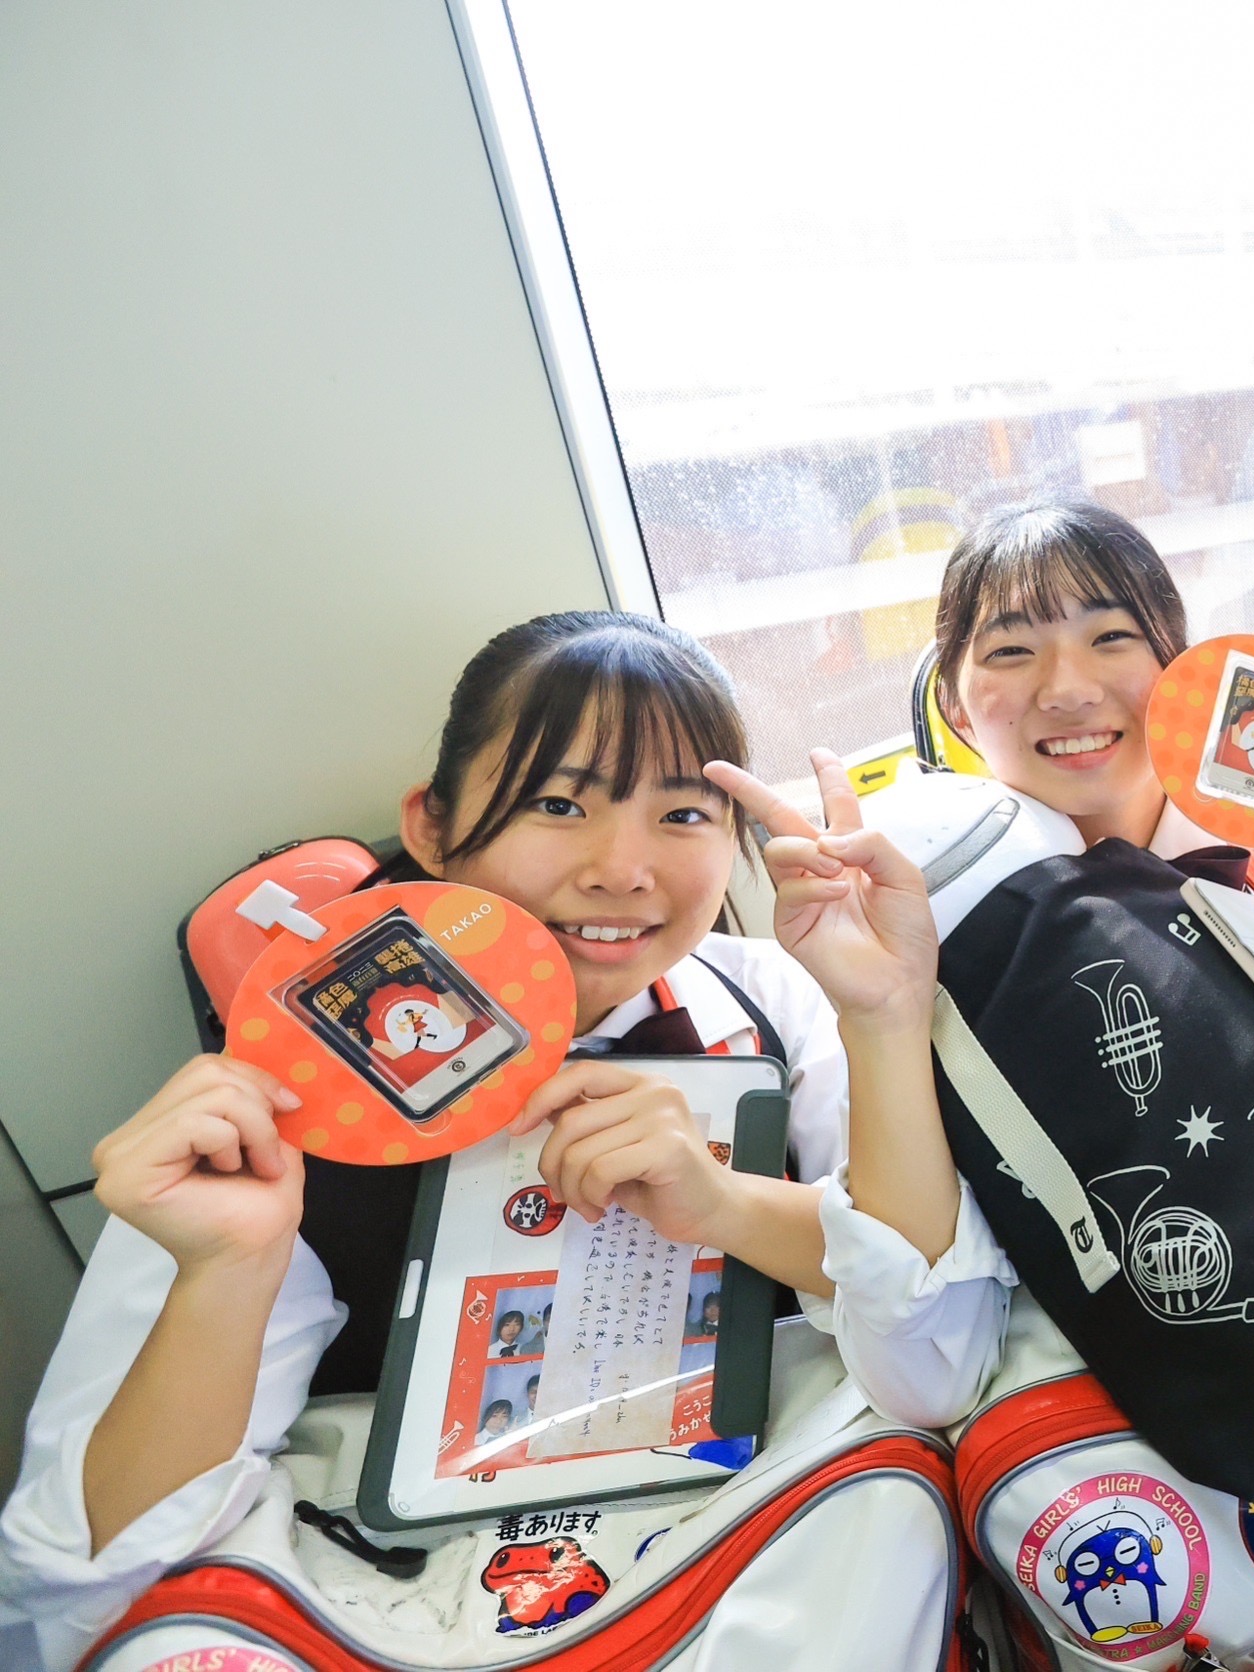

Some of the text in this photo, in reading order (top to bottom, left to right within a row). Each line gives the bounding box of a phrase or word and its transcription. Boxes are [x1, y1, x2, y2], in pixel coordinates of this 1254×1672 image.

[440, 903, 492, 941] TAKAO
[495, 1510, 602, 1541] 毒あります。
[1097, 1476, 1142, 1495] HIGH
[1152, 1486, 1202, 1551] SCHOOL
[1188, 1573, 1206, 1610] BAND
